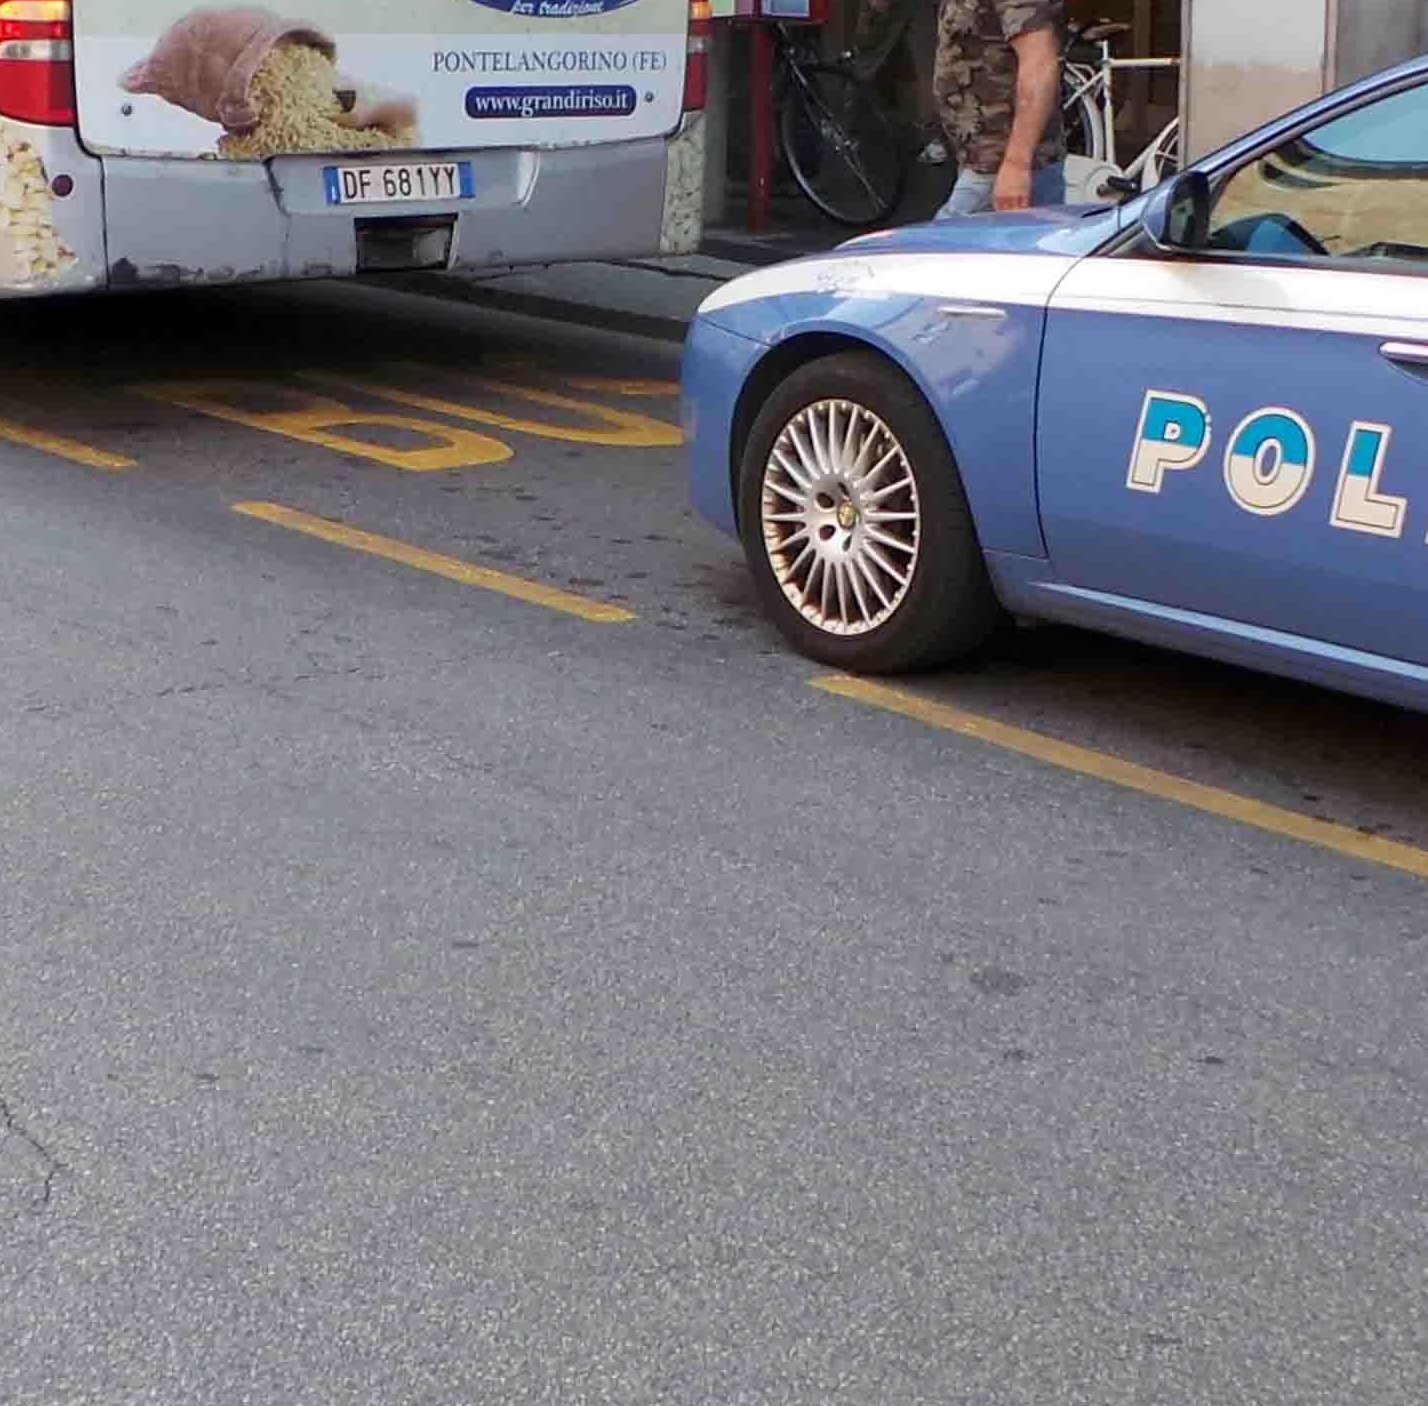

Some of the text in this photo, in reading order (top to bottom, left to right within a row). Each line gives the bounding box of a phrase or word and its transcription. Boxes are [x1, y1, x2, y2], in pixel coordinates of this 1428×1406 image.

[433, 51, 667, 72] PONTELANGORINO (FE)
[475, 89, 628, 118] www.grandiriso.it
[343, 169, 372, 199] DF
[383, 164, 456, 197] 681YY
